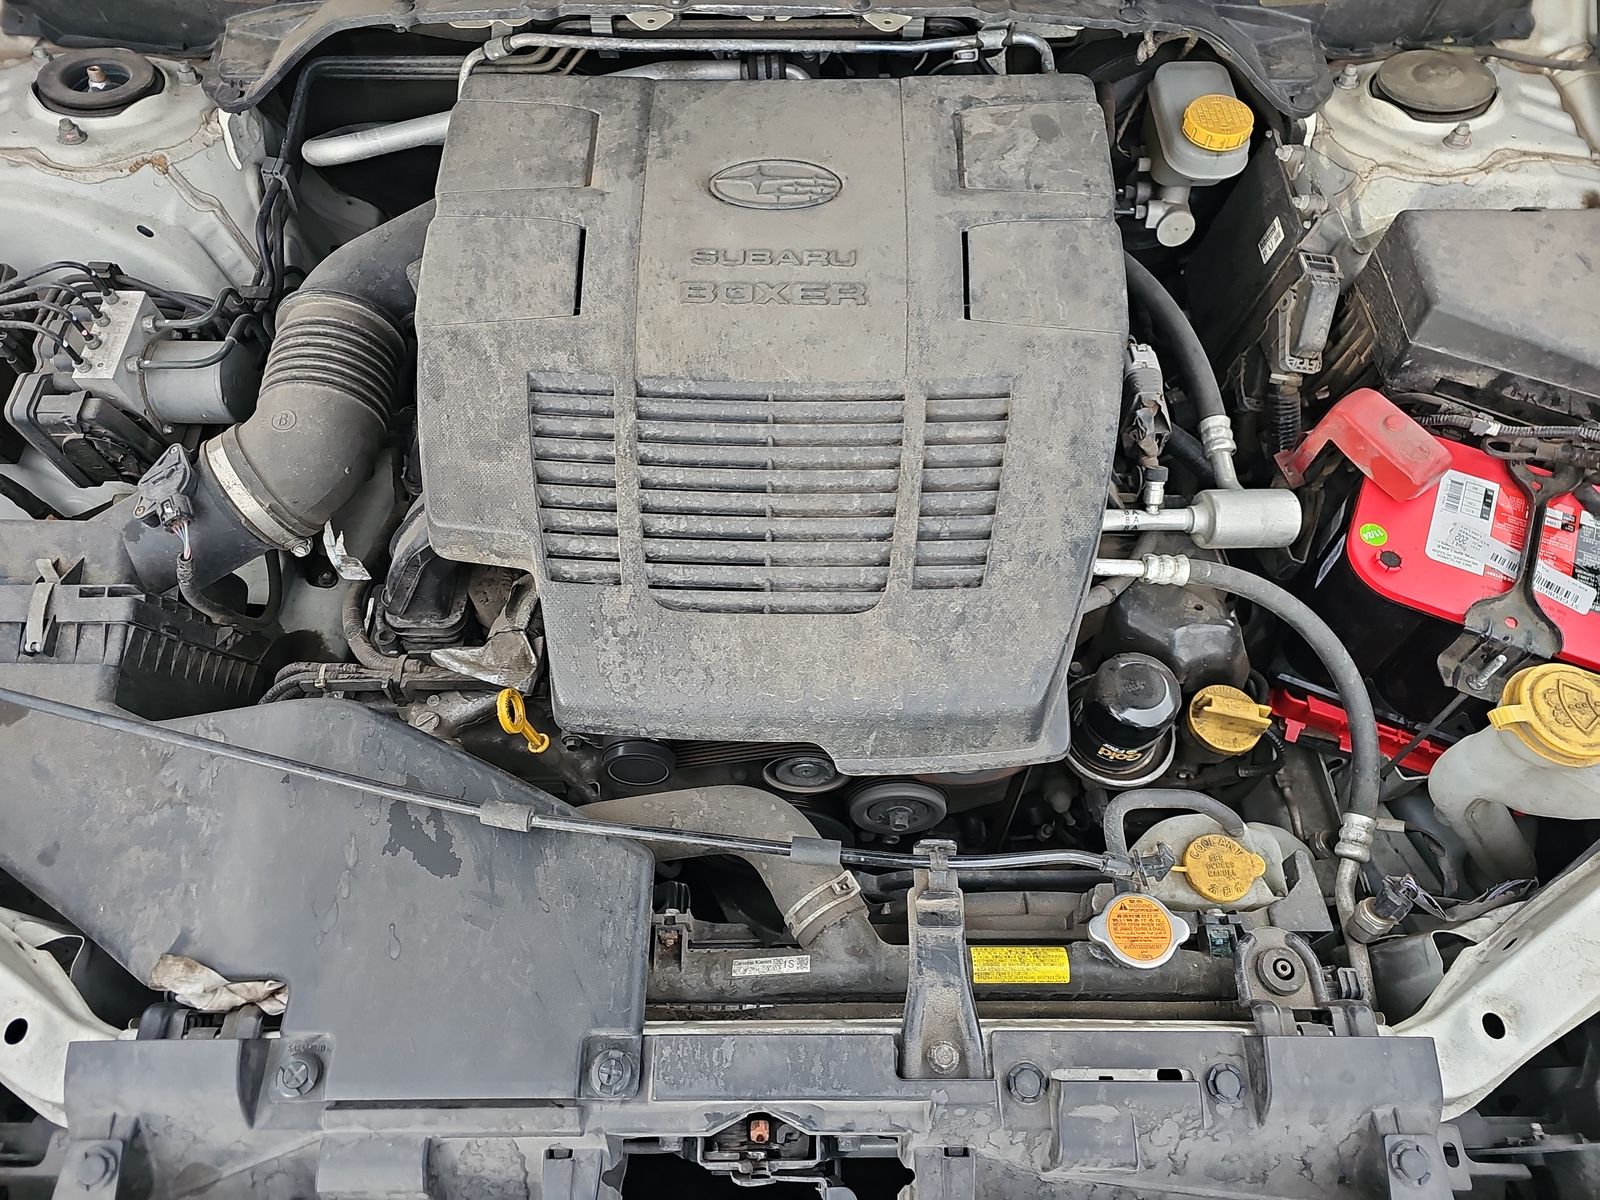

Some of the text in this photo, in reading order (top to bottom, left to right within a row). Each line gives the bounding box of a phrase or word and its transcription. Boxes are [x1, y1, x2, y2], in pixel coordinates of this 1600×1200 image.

[690, 250, 857, 267] SUBARU
[680, 282, 867, 306] BOXER
[1190, 837, 1243, 859] COOLANT
